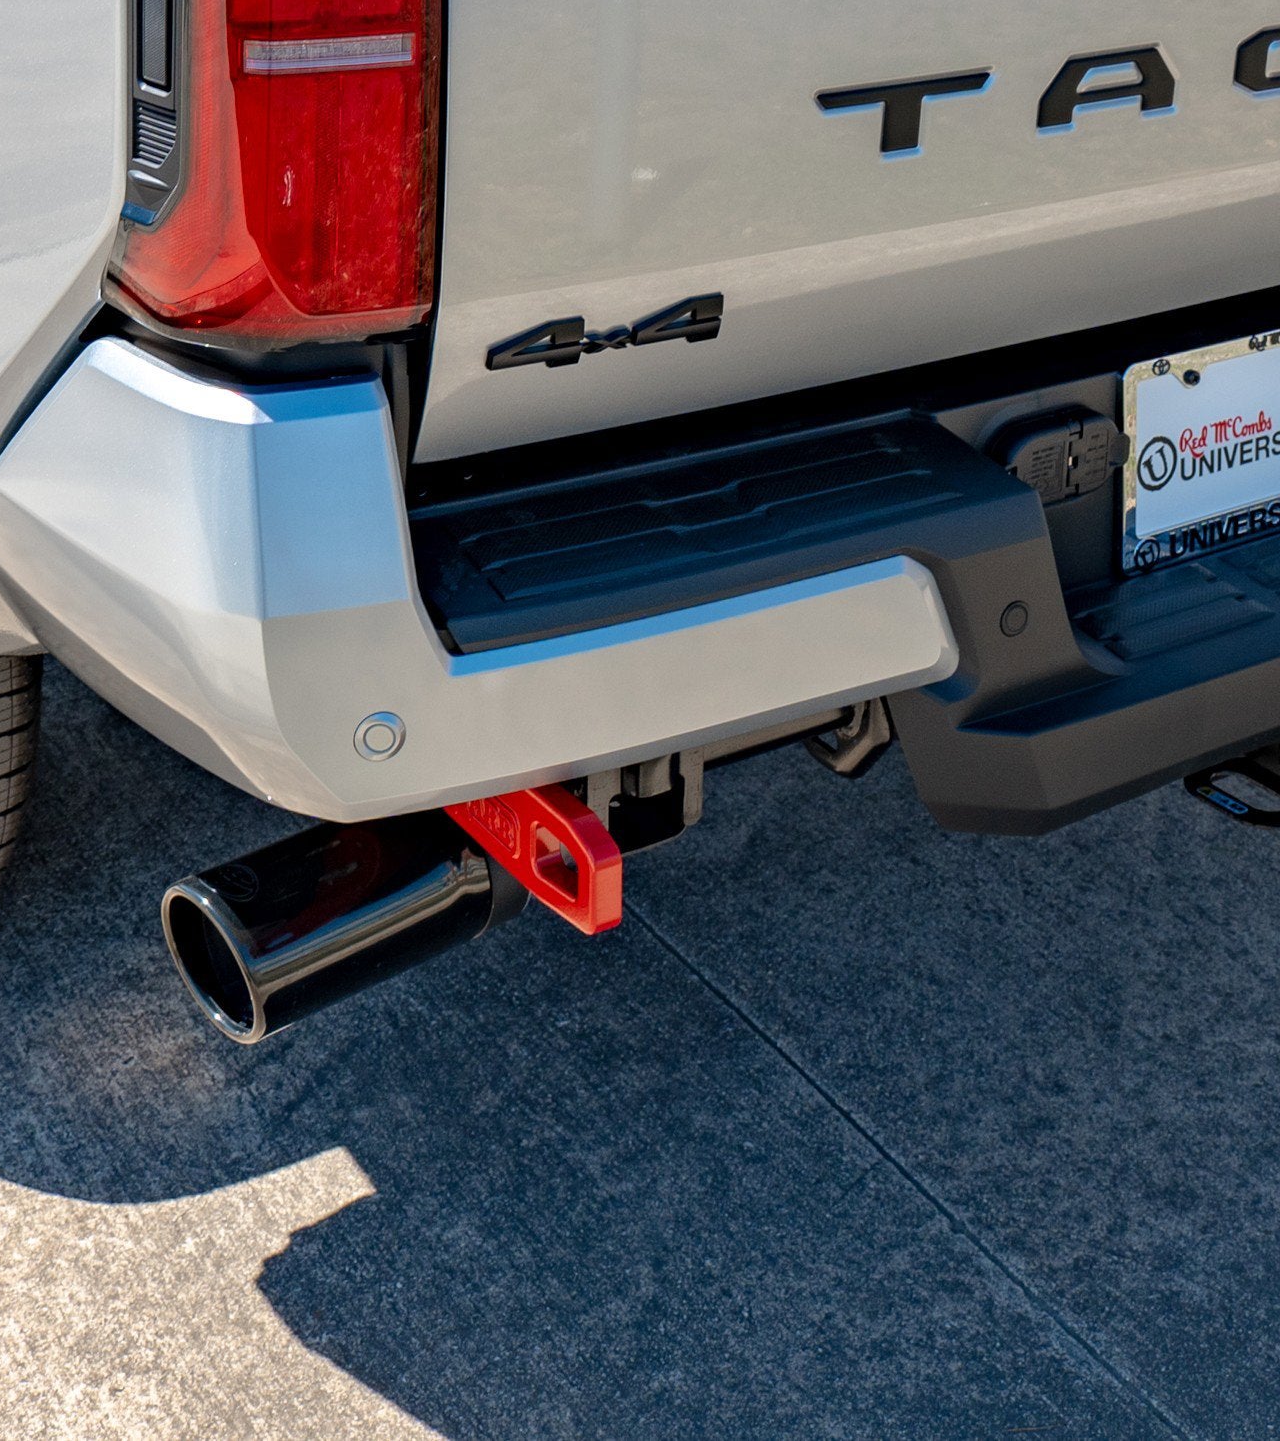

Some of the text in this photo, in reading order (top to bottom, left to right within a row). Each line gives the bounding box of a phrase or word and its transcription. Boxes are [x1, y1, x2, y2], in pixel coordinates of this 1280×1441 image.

[485, 292, 724, 371] 4x4
[1249, 334, 1267, 351] Red
[1180, 410, 1272, 458] Red McCombs
